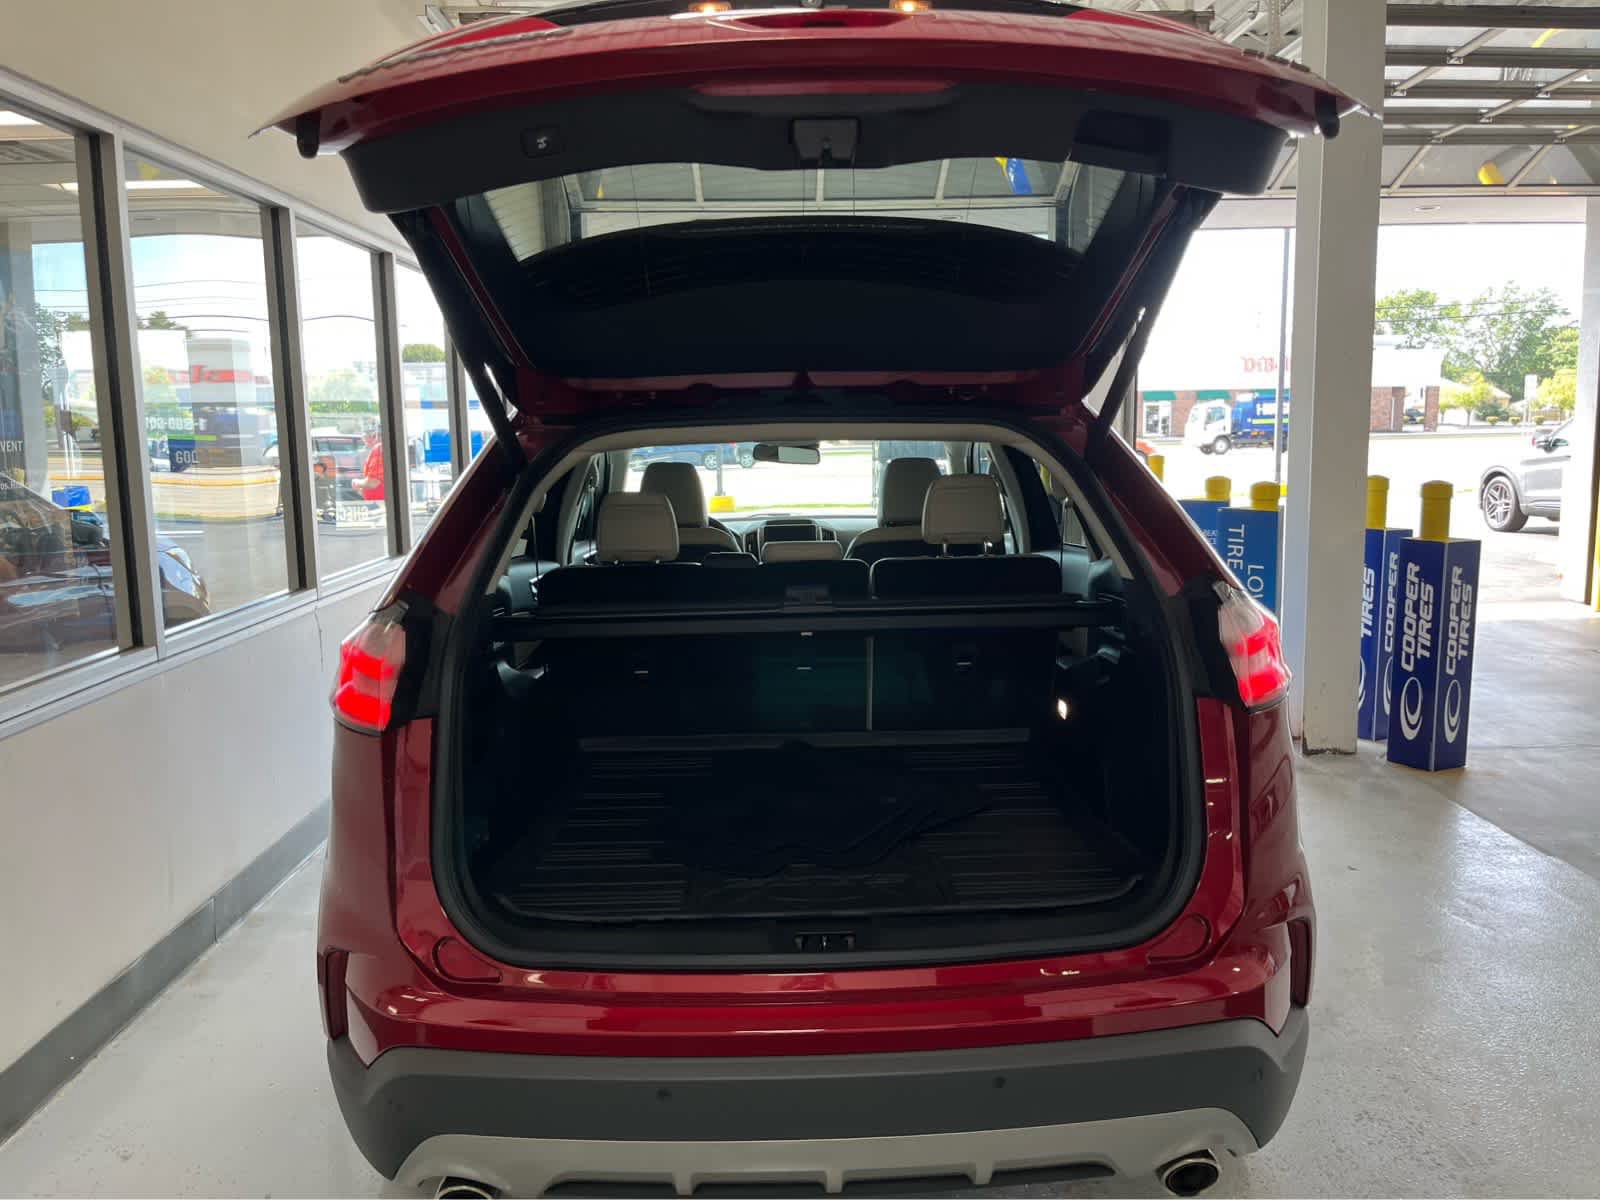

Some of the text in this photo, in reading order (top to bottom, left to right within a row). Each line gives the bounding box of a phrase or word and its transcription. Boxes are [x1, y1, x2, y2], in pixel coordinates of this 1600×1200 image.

[1227, 524, 1245, 570] TIRE
[1361, 566, 1375, 638] TIRES
[1384, 551, 1399, 653] COOPER
[1401, 561, 1421, 672] COOPER
[1417, 581, 1434, 659] TIRES
[1446, 566, 1463, 675] COOPER
[1458, 583, 1473, 660] TIRES
